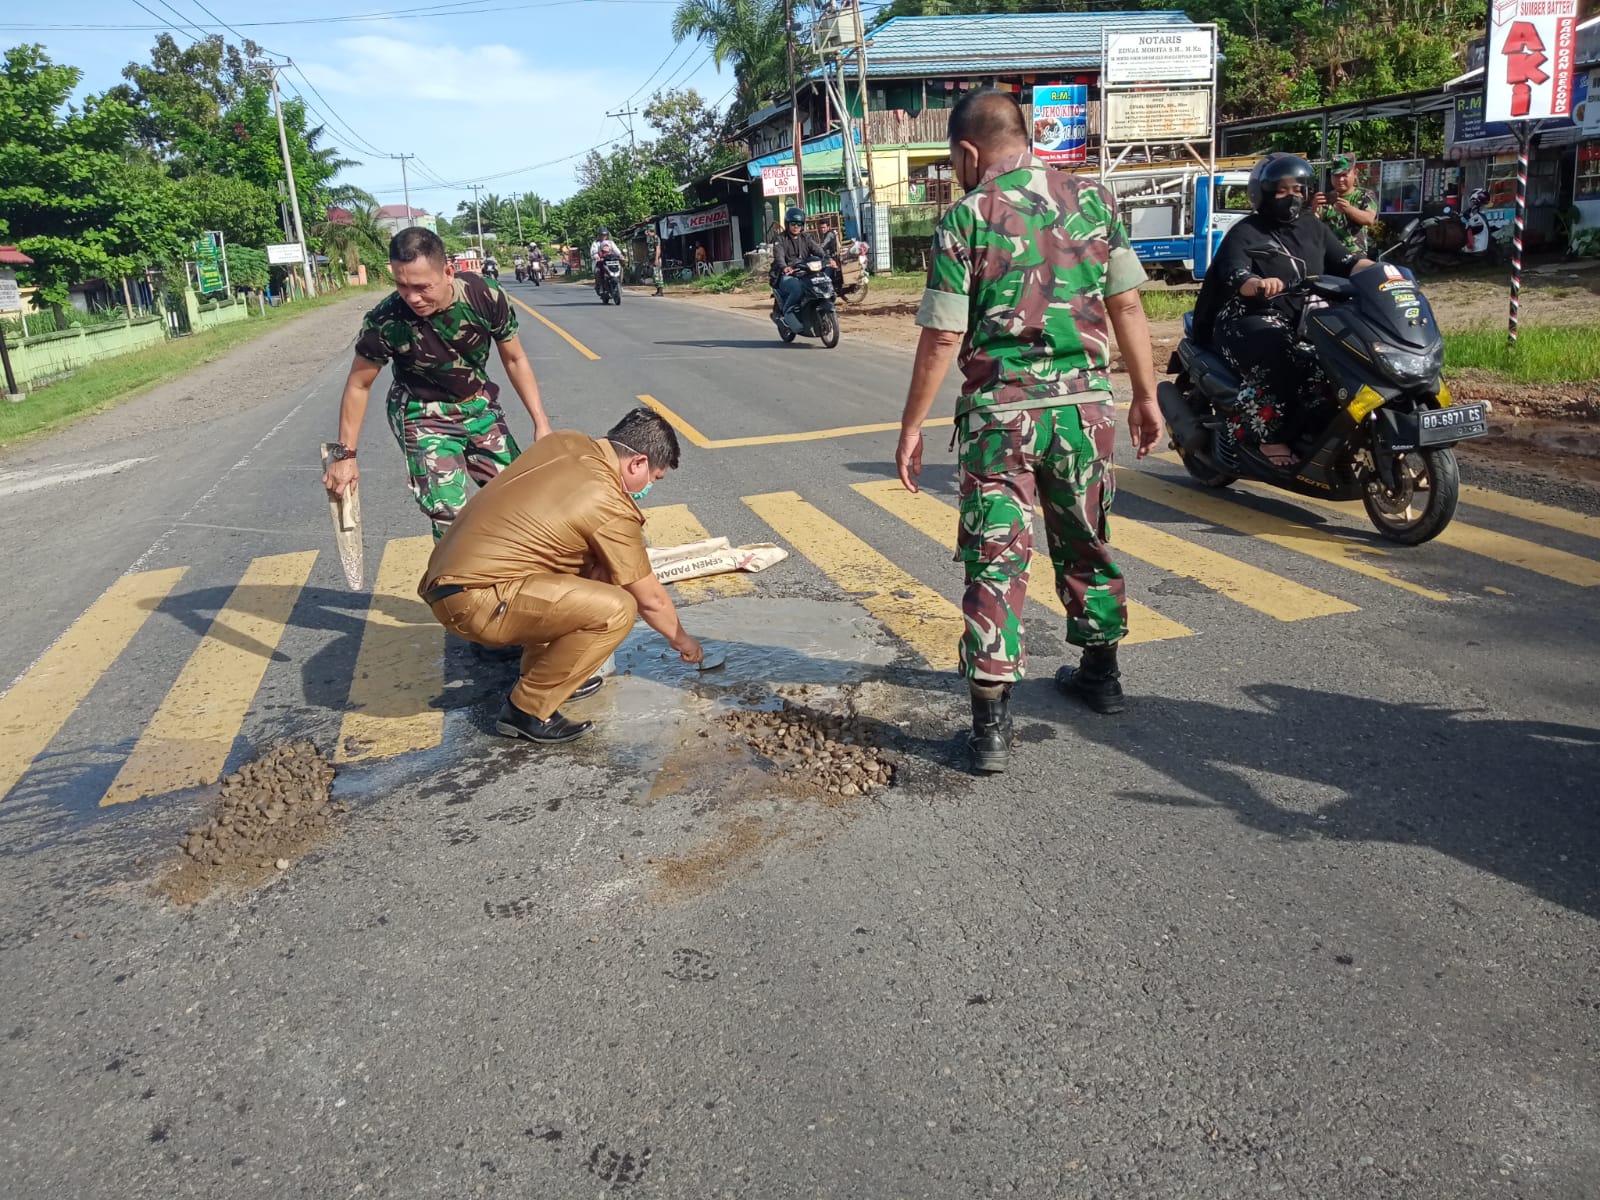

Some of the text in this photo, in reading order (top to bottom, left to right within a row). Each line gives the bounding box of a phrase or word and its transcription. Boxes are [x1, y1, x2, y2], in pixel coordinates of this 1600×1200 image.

[1520, 0, 1574, 16] SUMBER BATTERY
[1138, 35, 1182, 45] NOTARIS
[1501, 20, 1550, 117] AKI
[1554, 19, 1573, 113] BARU DAN SECOND
[763, 167, 796, 179] BENGKEL
[774, 177, 789, 187] LAS
[689, 210, 728, 227] KENDA
